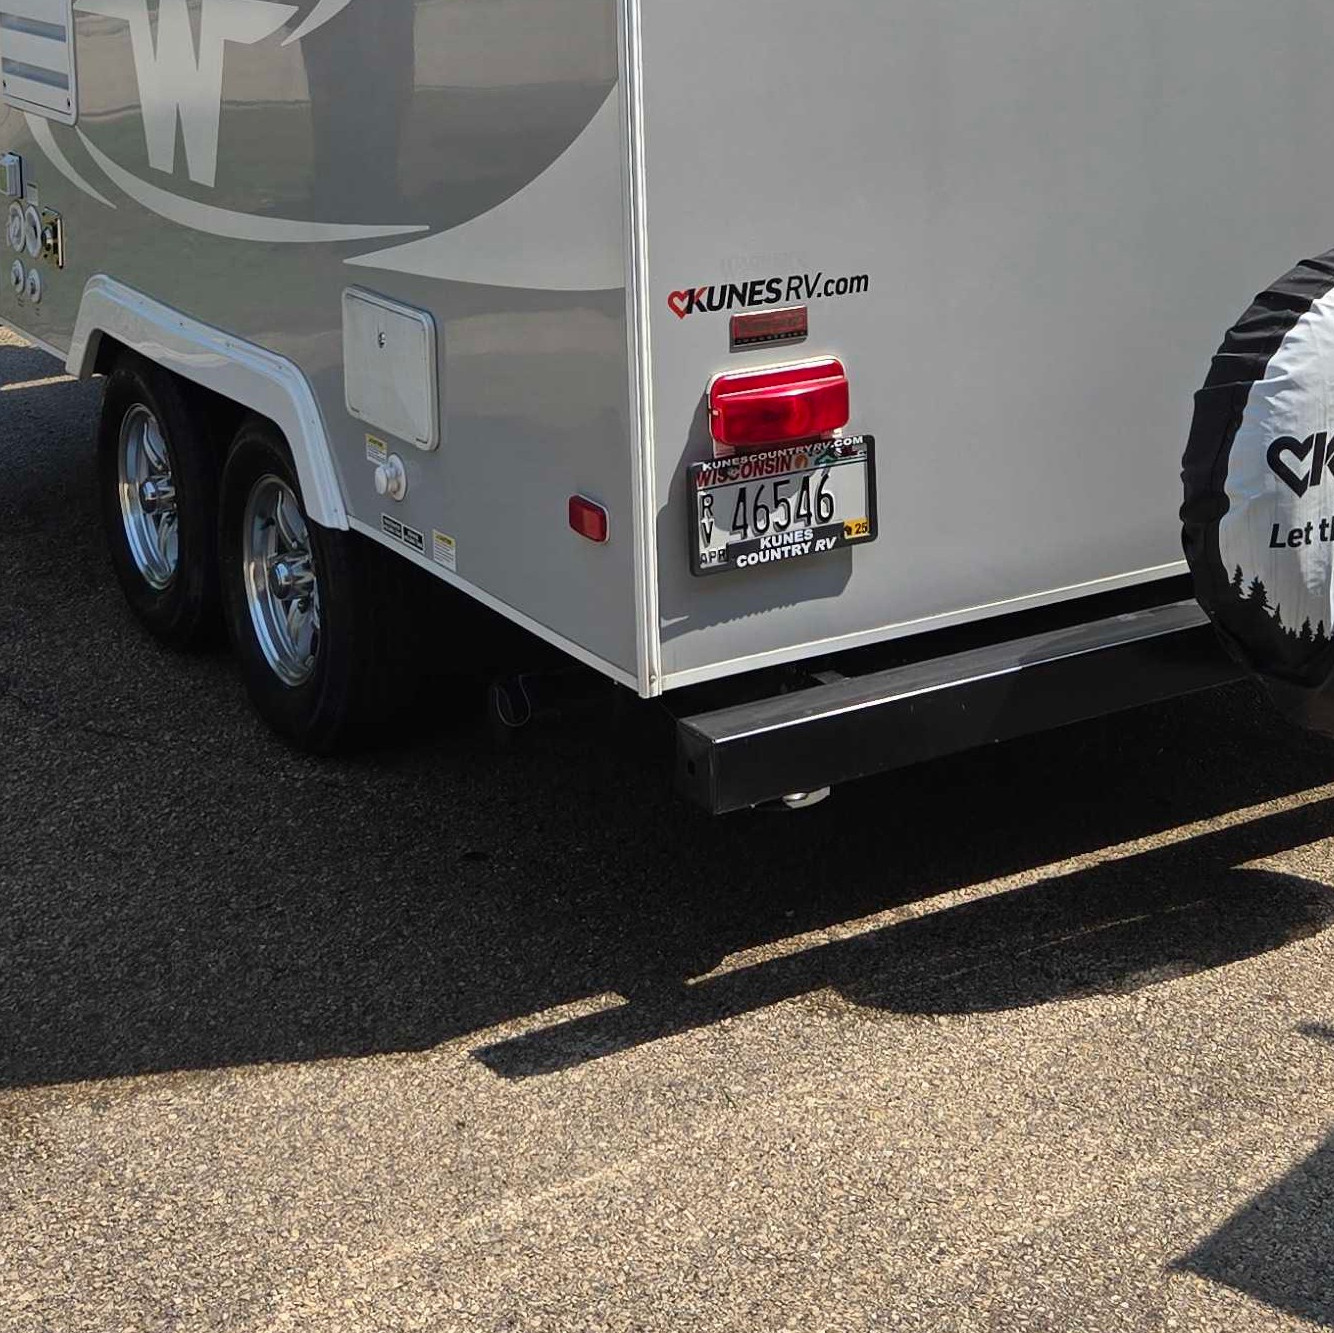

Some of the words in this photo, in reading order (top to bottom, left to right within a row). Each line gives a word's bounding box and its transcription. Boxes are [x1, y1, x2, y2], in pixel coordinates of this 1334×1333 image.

[695, 457, 791, 488] WISCONSIN
[732, 473, 835, 539] 46546
[760, 529, 814, 549] KUNES
[1269, 522, 1313, 548] Let
[700, 549, 728, 565] APR
[736, 541, 814, 568] COUNTRY
[814, 537, 837, 552] RV
